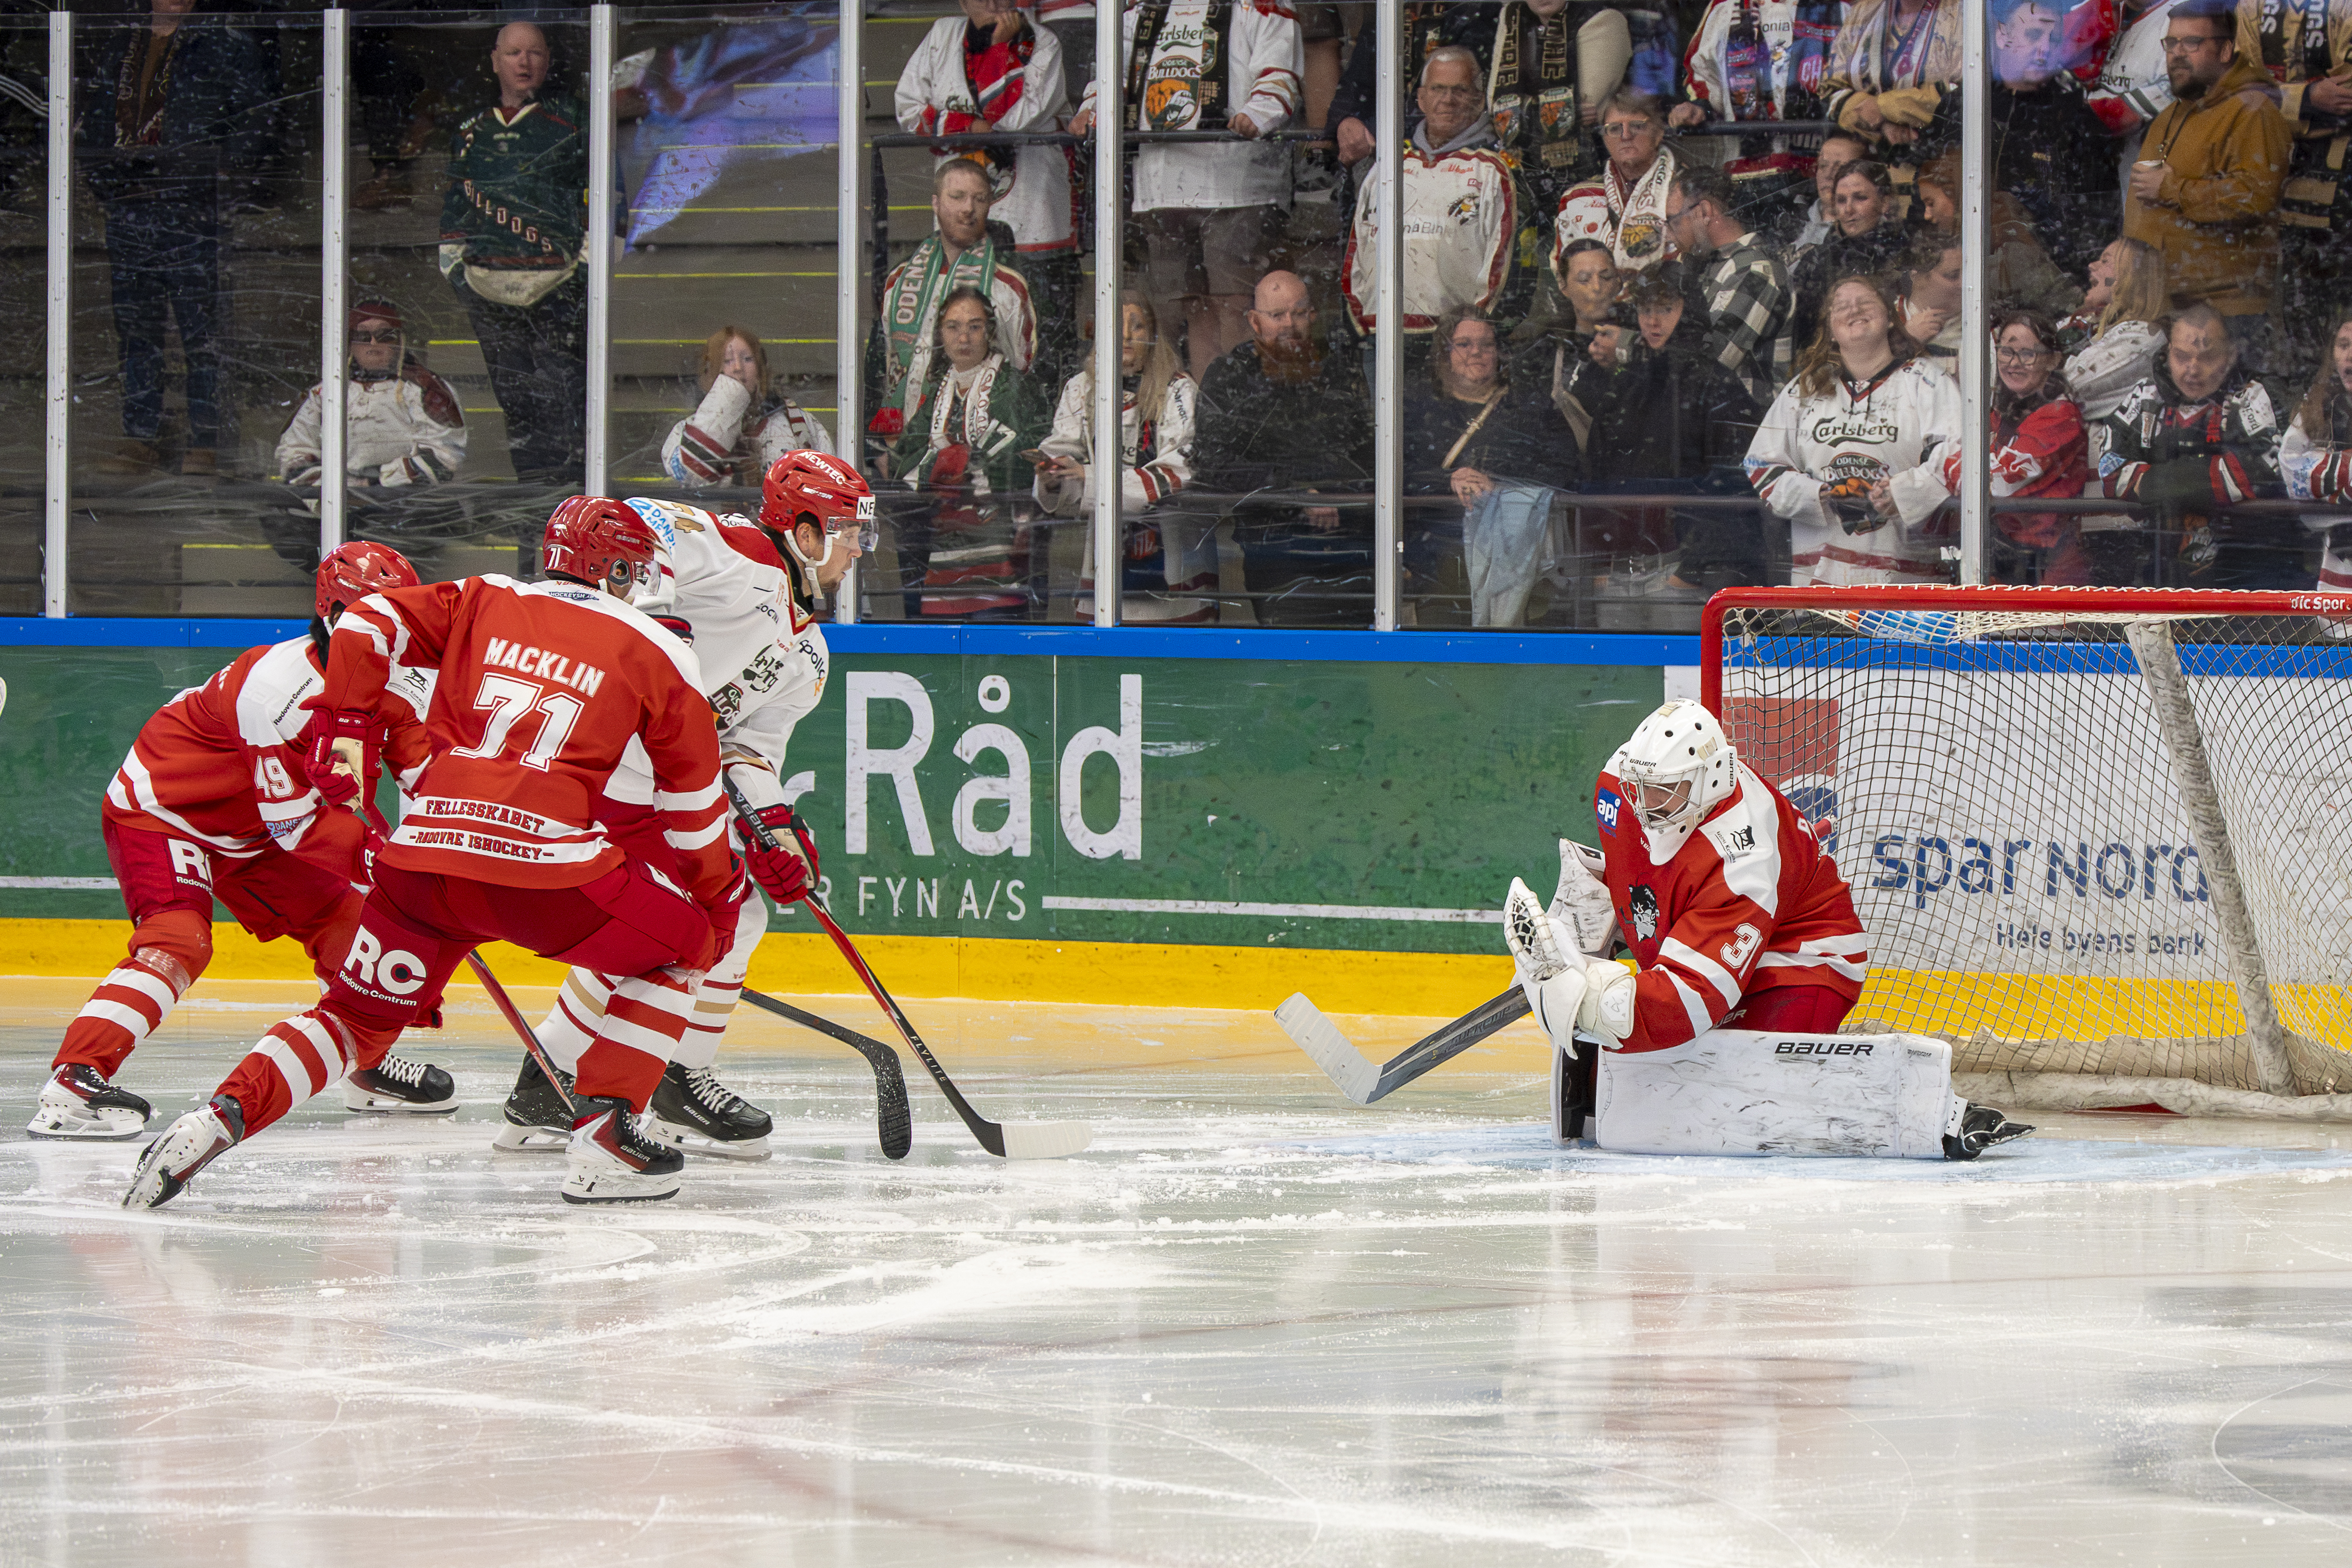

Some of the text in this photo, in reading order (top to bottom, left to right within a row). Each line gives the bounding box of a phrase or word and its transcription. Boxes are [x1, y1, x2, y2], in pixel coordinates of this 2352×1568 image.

[1812, 416, 1898, 445] Carlsberg
[802, 451, 846, 485] NEWTEC
[548, 547, 561, 569] 71
[482, 637, 606, 698] MACKLIN
[292, 677, 313, 699] Centrum
[449, 671, 586, 773] 71
[253, 755, 295, 799] 49
[846, 671, 1143, 860] Råd
[1629, 758, 1657, 768] BAUER
[426, 800, 545, 833] FÆLLESSKABET
[741, 802, 776, 847] BAUE
[1597, 798, 1622, 827] apj
[1872, 835, 2031, 909] spar
[858, 876, 938, 918] FYN
[958, 878, 1026, 921] A/S
[1719, 922, 1763, 974] 3
[1997, 923, 2206, 956] Hele byens bank
[343, 924, 427, 995] RC
[370, 990, 417, 1007] Centrum
[910, 1036, 947, 1082] FLYLITE
[1775, 1042, 1875, 1056] BAUER
[683, 1104, 711, 1125] BAUER
[620, 1145, 651, 1162] BAUER
